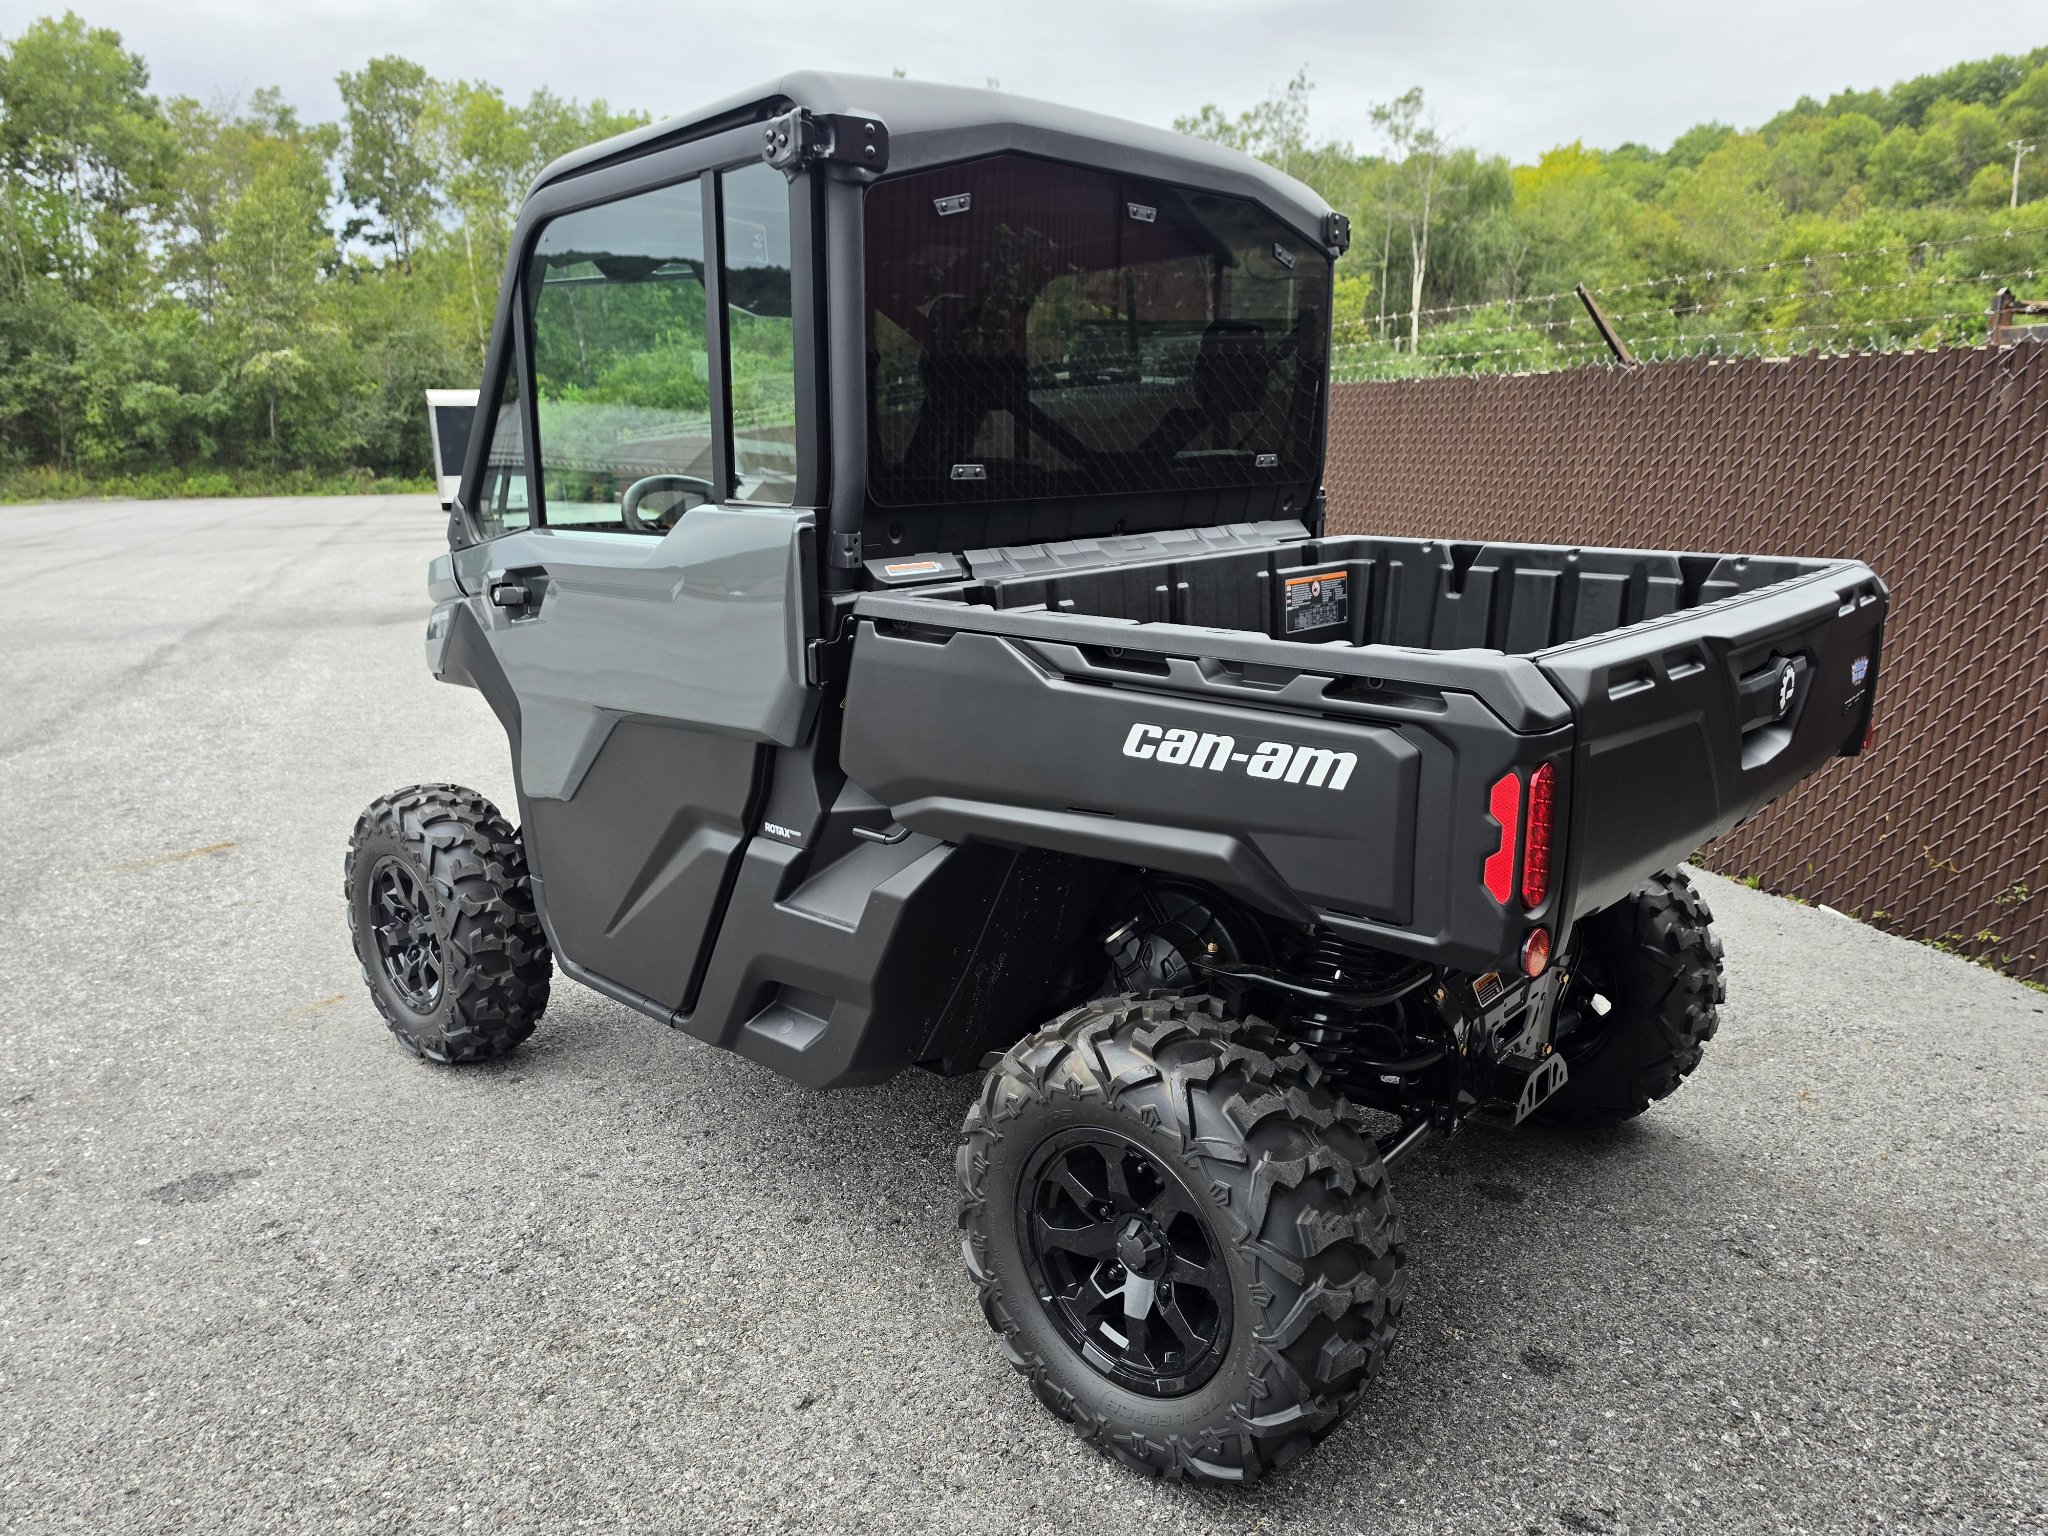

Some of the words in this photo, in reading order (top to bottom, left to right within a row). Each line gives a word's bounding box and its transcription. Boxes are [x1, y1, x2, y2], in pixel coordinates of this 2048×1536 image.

[1122, 722, 1358, 791] can-am
[764, 821, 791, 839] ROTAX
[1105, 1400, 1172, 1427] FORCE
